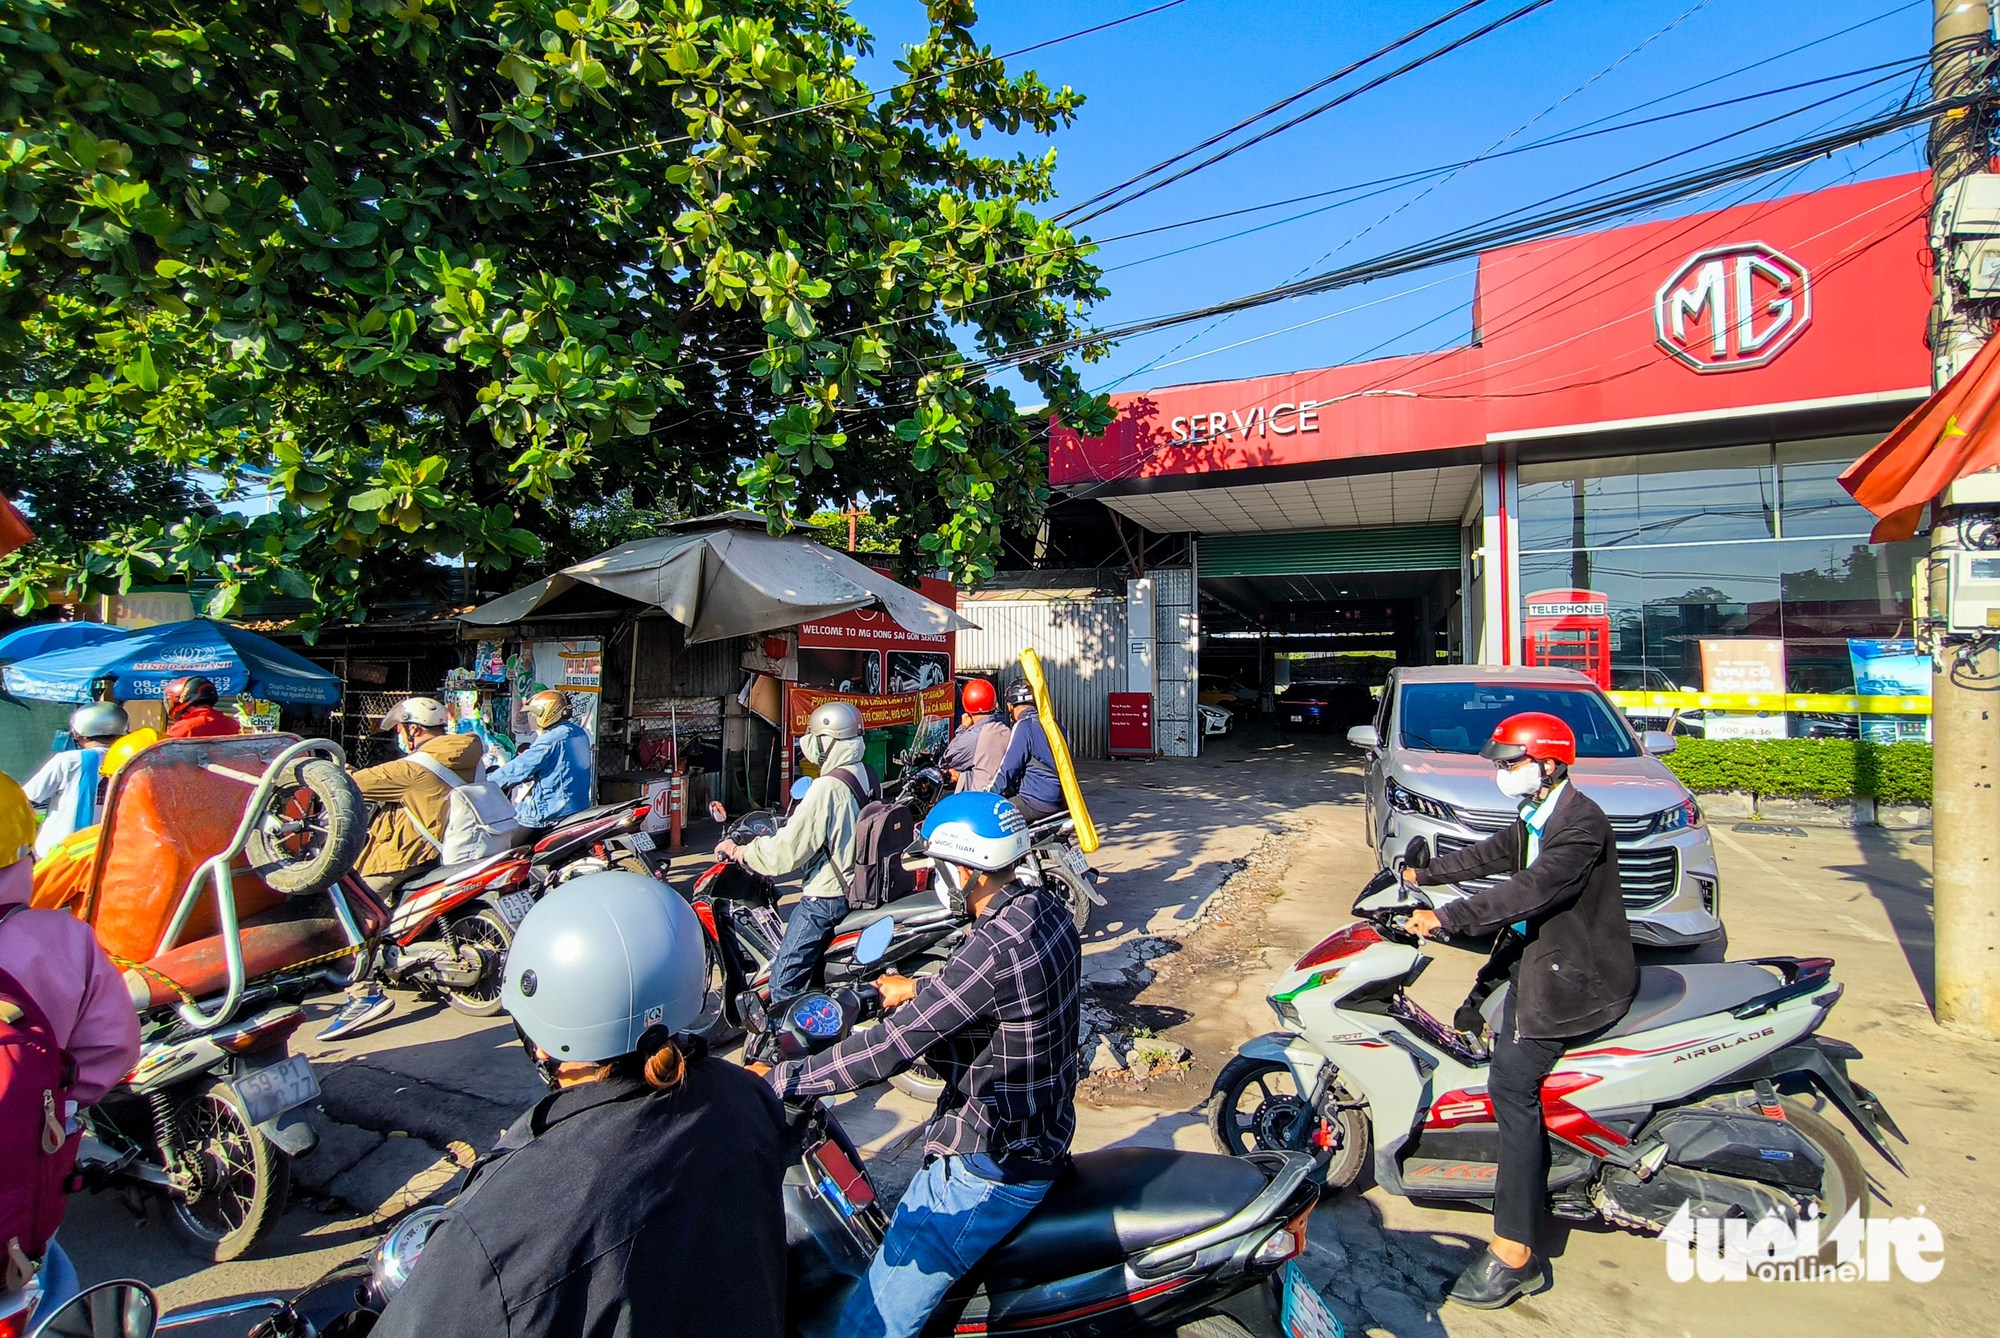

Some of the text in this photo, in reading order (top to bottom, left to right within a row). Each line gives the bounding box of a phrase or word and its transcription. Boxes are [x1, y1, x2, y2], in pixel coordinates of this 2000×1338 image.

[1671, 254, 1792, 357] MG
[1170, 400, 1319, 444] SERVICE
[1531, 604, 1603, 614] TELEPHONE
[802, 624, 843, 636] WELCOME
[845, 627, 856, 637] TO
[858, 628, 871, 638] MG
[873, 630, 892, 639] DONG
[893, 631, 905, 640] SAI
[921, 634, 947, 643] SERVICES
[1713, 667, 1746, 677] THU
[1714, 726, 1739, 735] 1900
[1758, 728, 1772, 736] 36
[502, 892, 530, 909] 61-L5
[1332, 1032, 1364, 1041] SPORT
[1673, 1026, 1775, 1064] AIRBLADE
[247, 1060, 300, 1095] 59-P1
